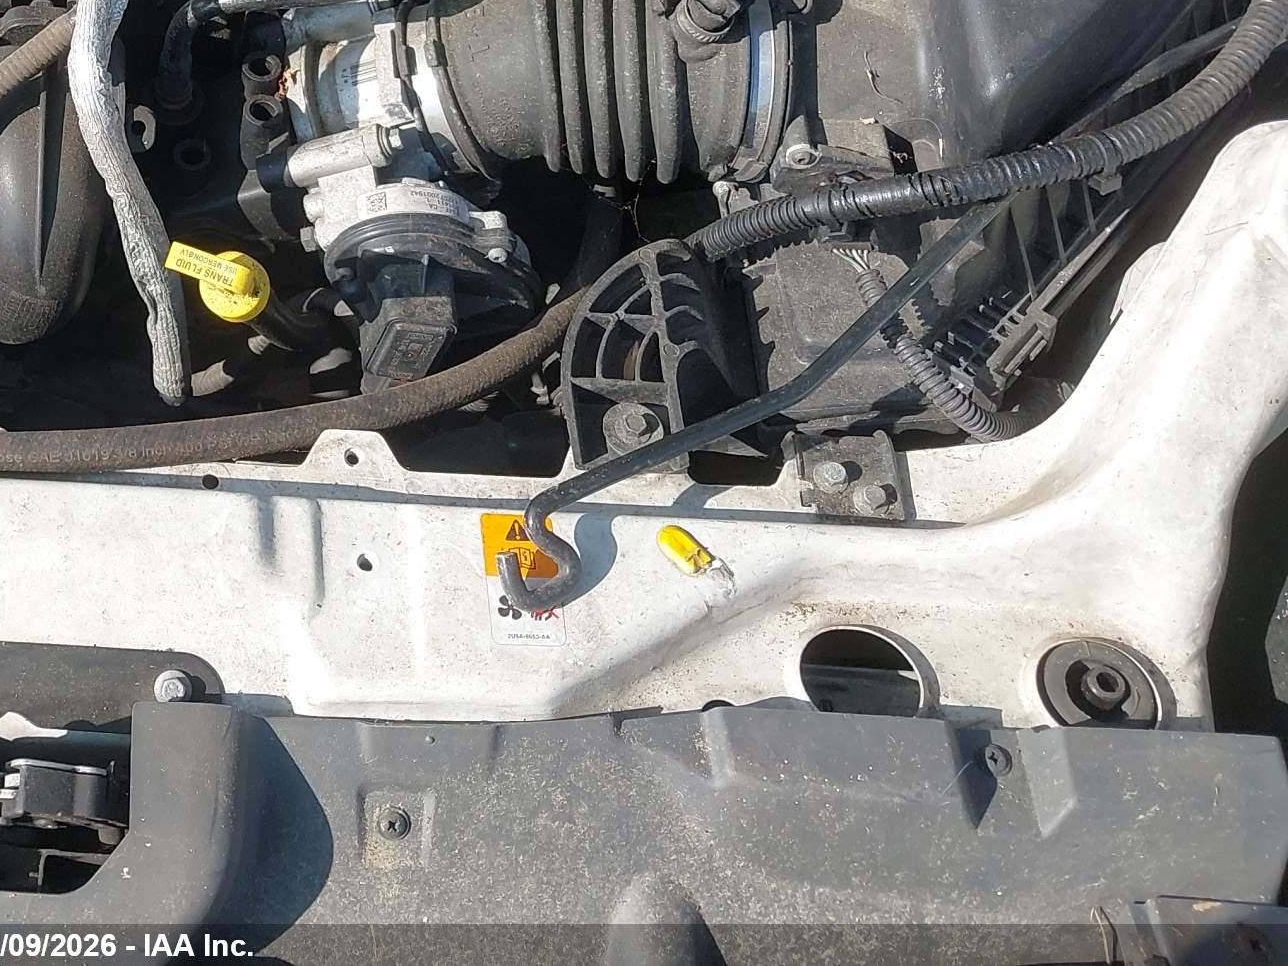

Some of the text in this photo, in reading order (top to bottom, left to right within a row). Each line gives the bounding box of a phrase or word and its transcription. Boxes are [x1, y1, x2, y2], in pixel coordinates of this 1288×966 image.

[175, 258, 233, 287] TRANS FLUID
[225, 264, 238, 275] USE
